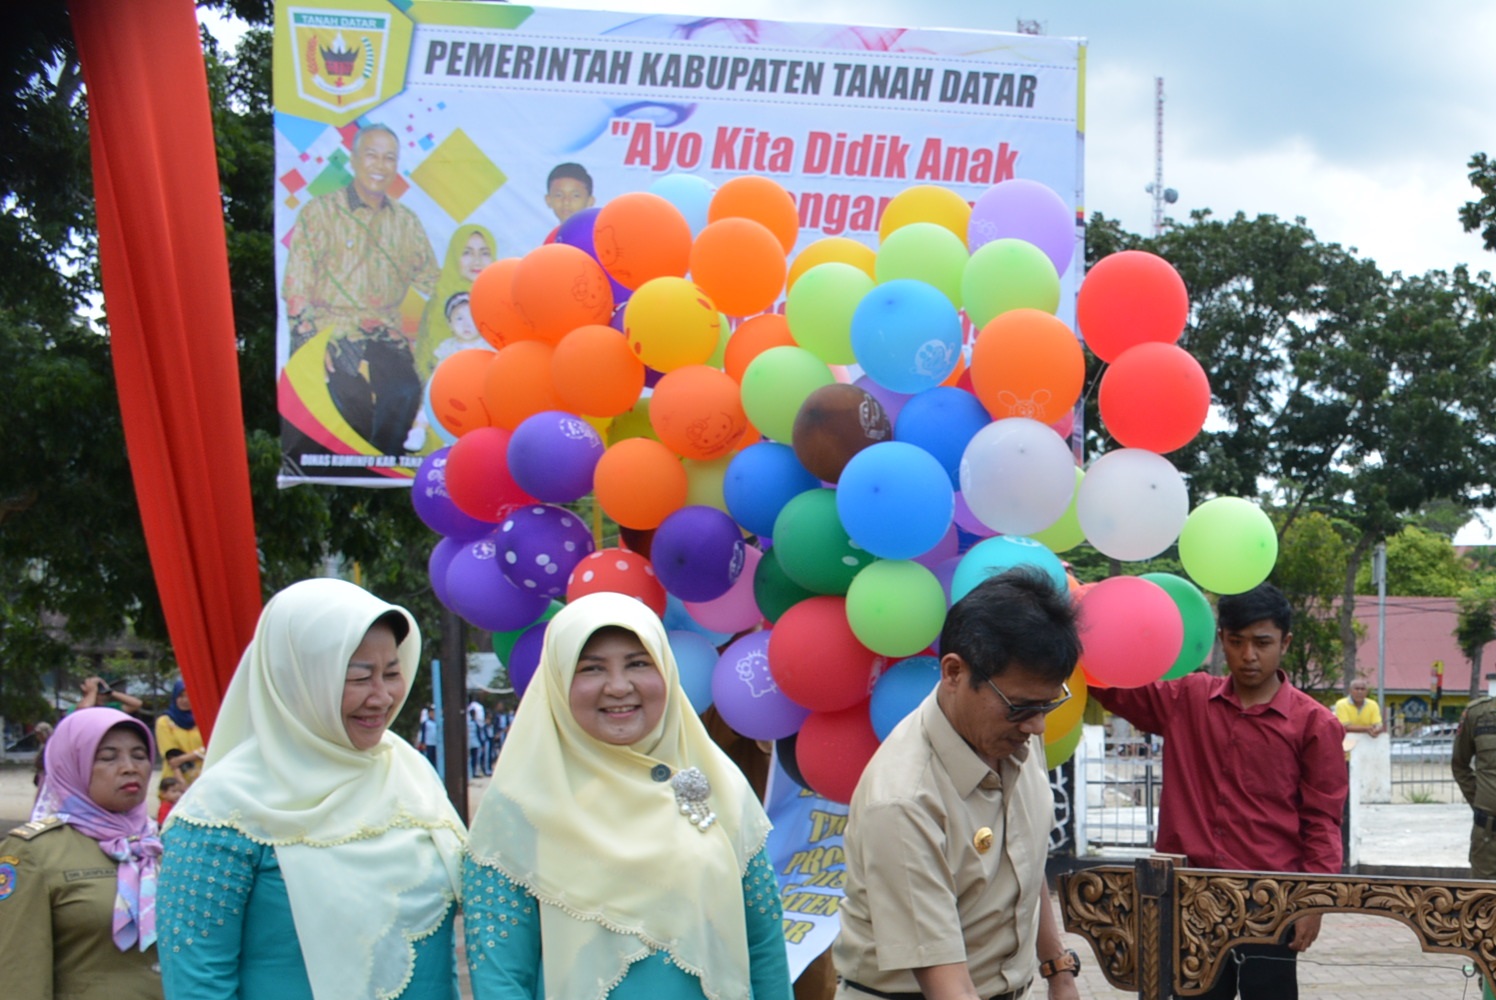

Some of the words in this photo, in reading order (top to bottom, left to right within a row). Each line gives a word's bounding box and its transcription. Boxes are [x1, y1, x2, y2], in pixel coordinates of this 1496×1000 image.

[302, 15, 338, 26] TANAH
[341, 18, 377, 28] DATAR
[424, 39, 632, 85] PEMERINTAH
[638, 52, 824, 96] KABUPATEN
[833, 63, 933, 101] TANAH
[938, 69, 1038, 108] DATAR
[610, 120, 702, 172] "Ayo
[711, 126, 794, 173] Kita
[802, 131, 910, 179] Didik
[915, 137, 1018, 185] Anak
